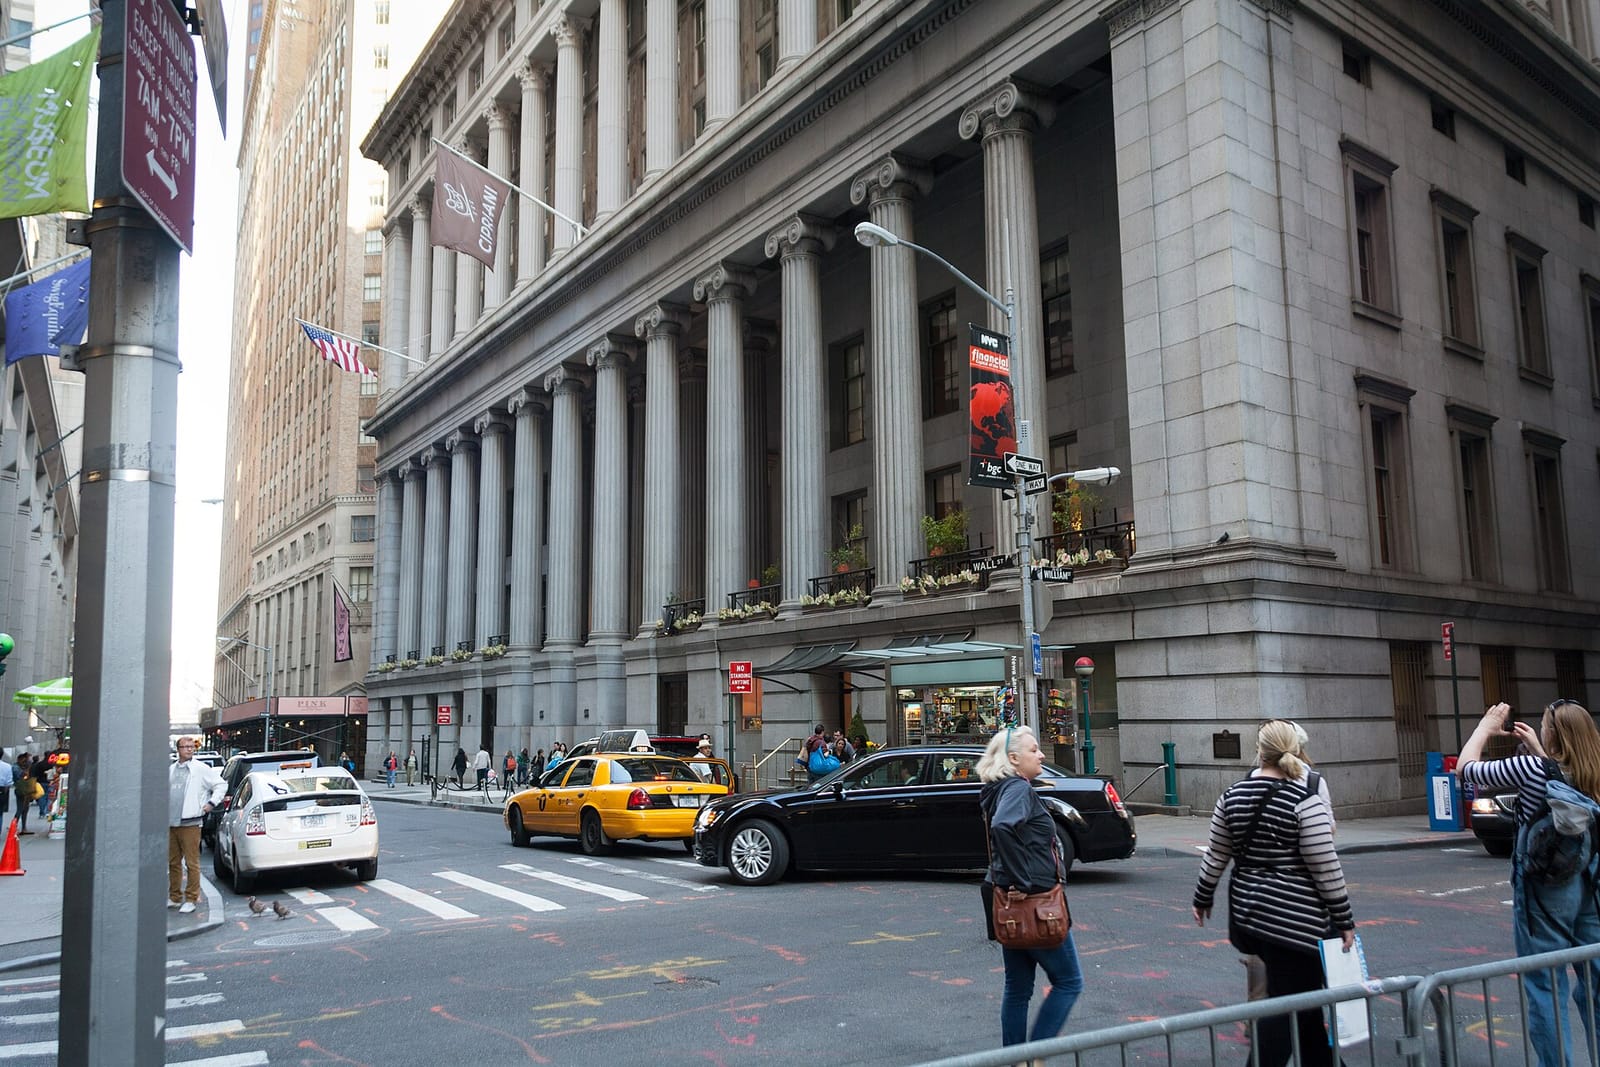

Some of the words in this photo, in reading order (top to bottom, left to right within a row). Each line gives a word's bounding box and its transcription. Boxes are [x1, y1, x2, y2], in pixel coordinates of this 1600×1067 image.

[152, 0, 194, 83] STANDING
[134, 7, 162, 67] EXCEPT
[165, 55, 191, 110] TRUCKS
[128, 31, 156, 81] LOADING
[165, 84, 195, 138] UNLOADING
[145, 120, 158, 149] MON
[24, 90, 61, 200] MUSEUM
[478, 184, 498, 254] CIPRIANI
[981, 333, 998, 348] NYC
[971, 348, 1008, 369] financial
[987, 462, 1002, 475] bgc
[1016, 460, 1026, 470] ONE
[1028, 463, 1040, 471] WAY
[1028, 479, 1043, 489] WAY
[972, 560, 997, 572] WALL
[1044, 568, 1068, 580] WILLIAM
[298, 700, 327, 708] PINK
